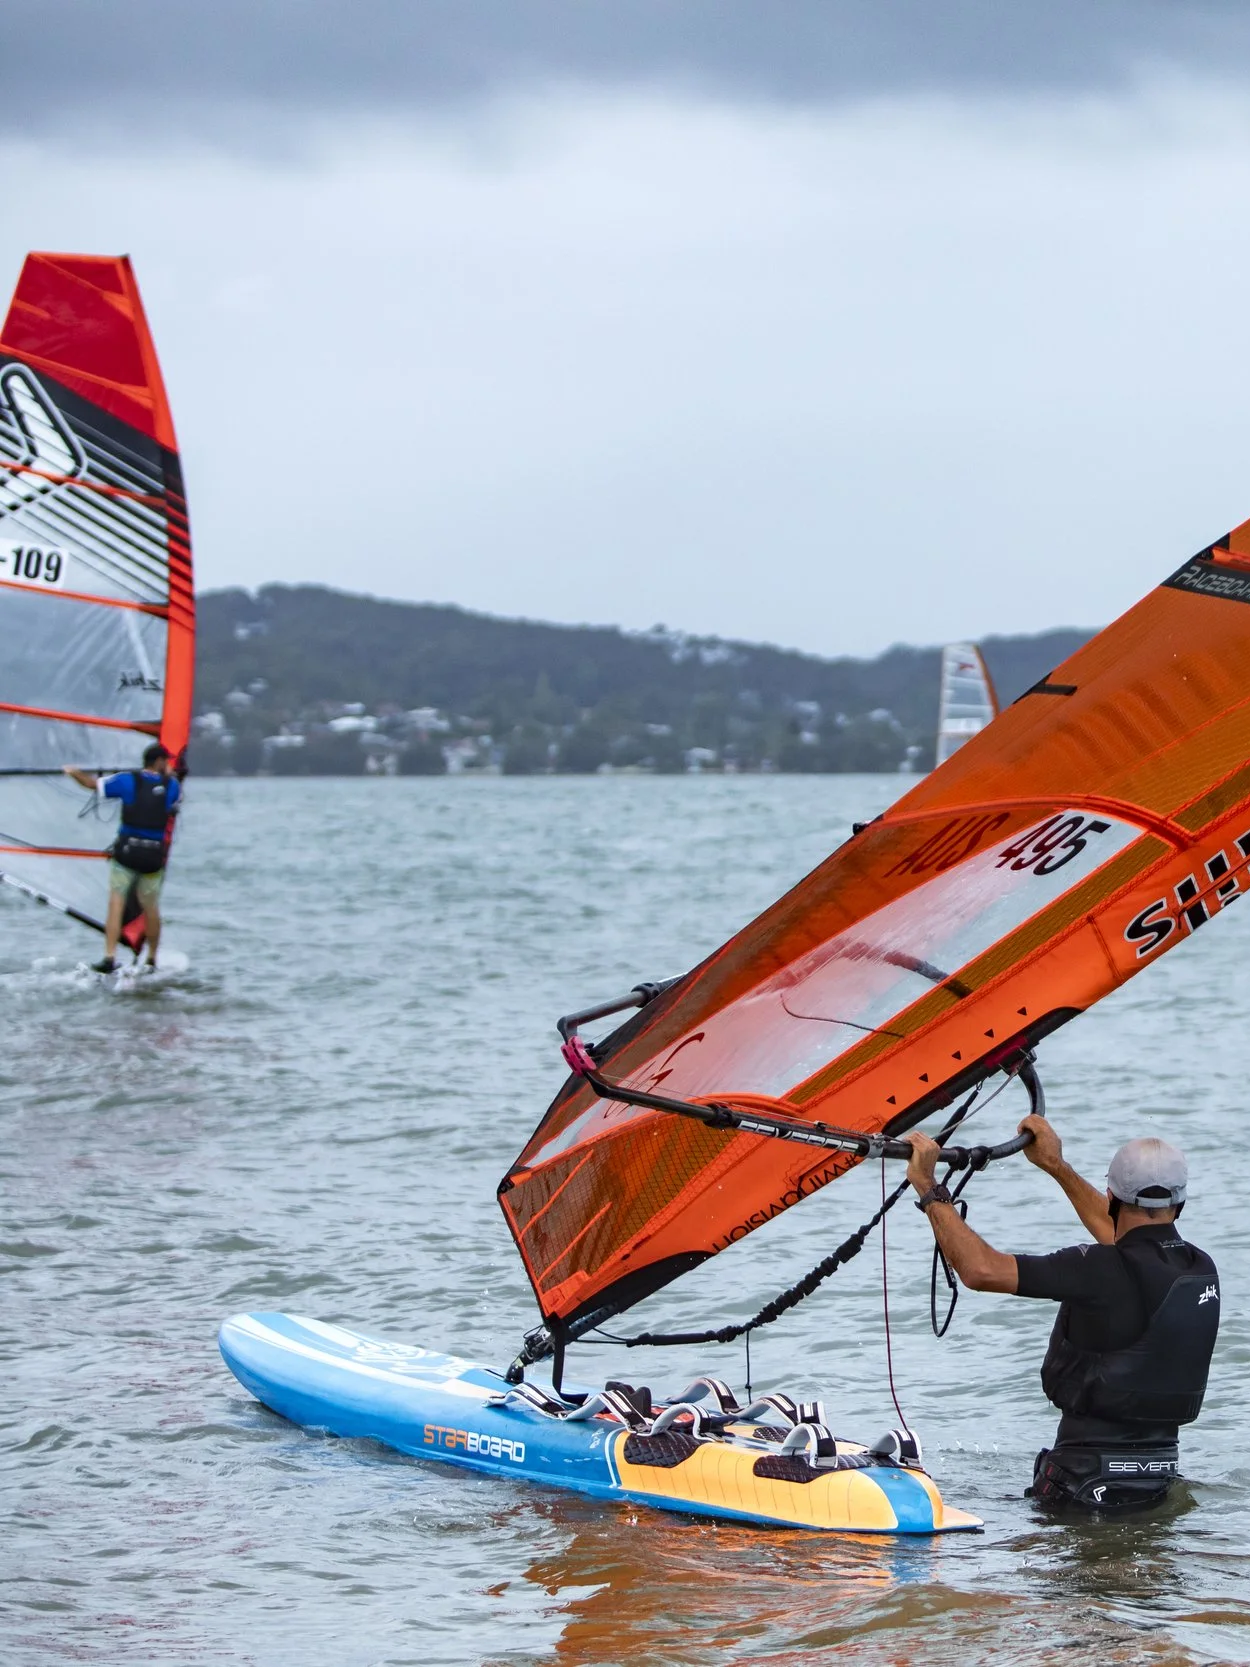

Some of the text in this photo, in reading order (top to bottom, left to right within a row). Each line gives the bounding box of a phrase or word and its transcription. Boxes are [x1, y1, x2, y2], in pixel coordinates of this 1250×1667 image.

[882, 811, 1112, 878] AUS 495
[1198, 1284, 1219, 1305] zhik
